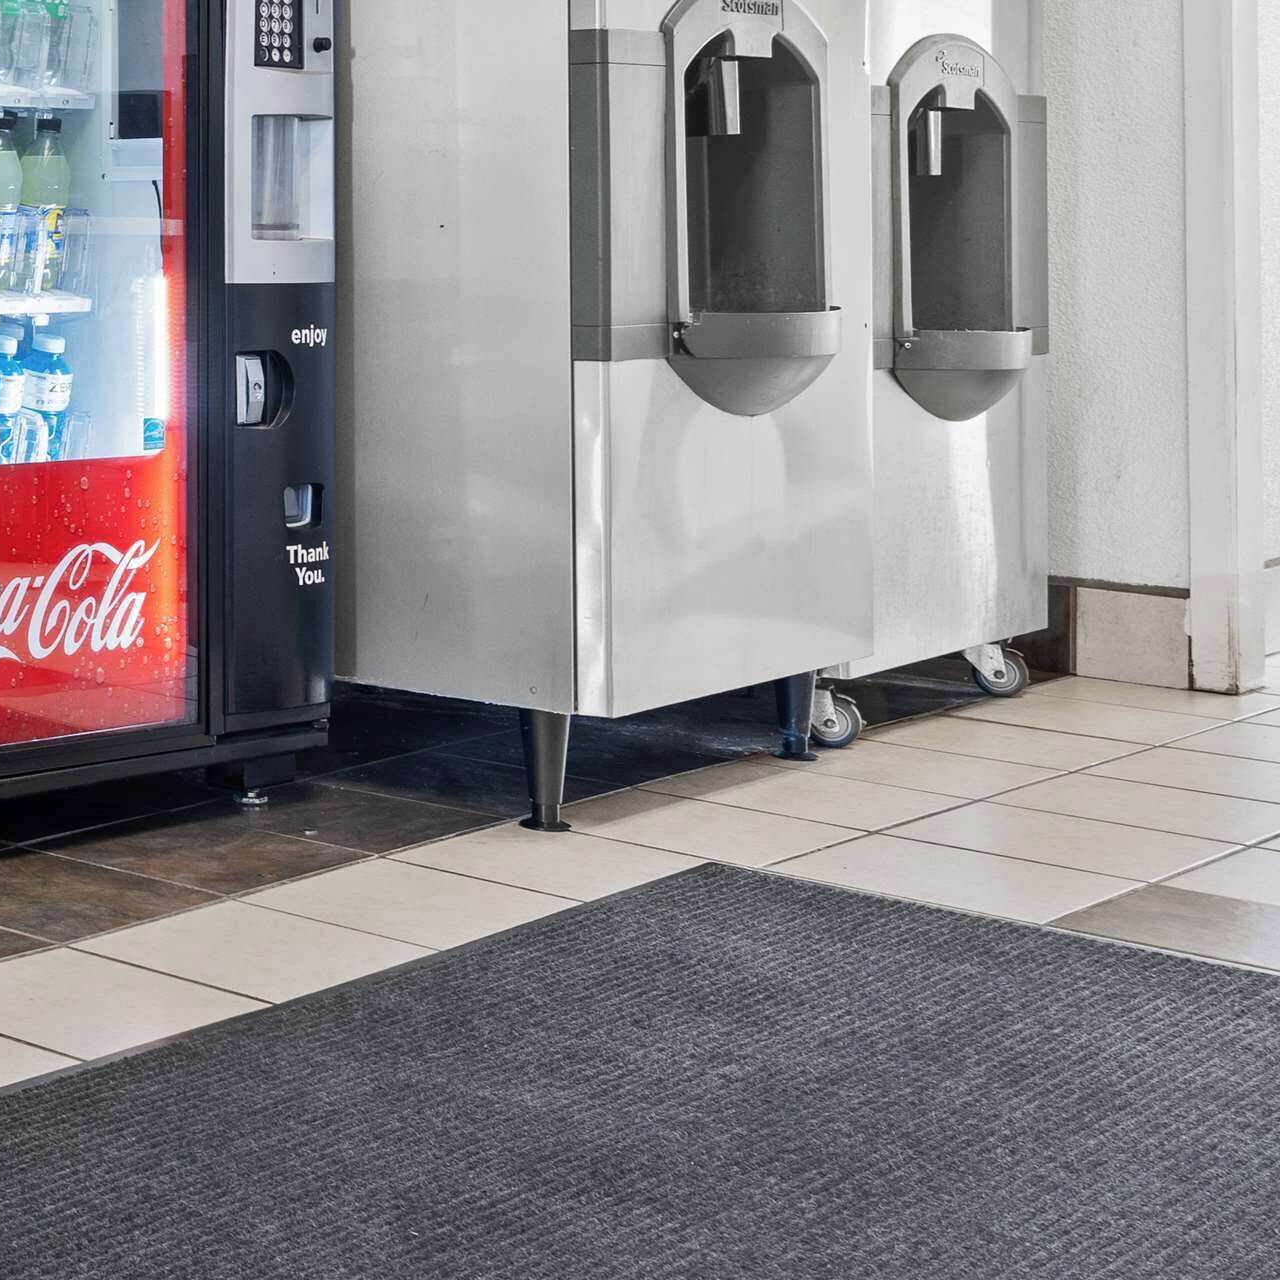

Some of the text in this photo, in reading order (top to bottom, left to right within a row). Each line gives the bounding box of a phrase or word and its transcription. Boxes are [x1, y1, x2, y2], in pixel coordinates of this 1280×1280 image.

[941, 59, 981, 78] Scotsman
[291, 324, 327, 347] enjoy
[286, 541, 330, 564] Thank
[294, 567, 326, 586] You.
